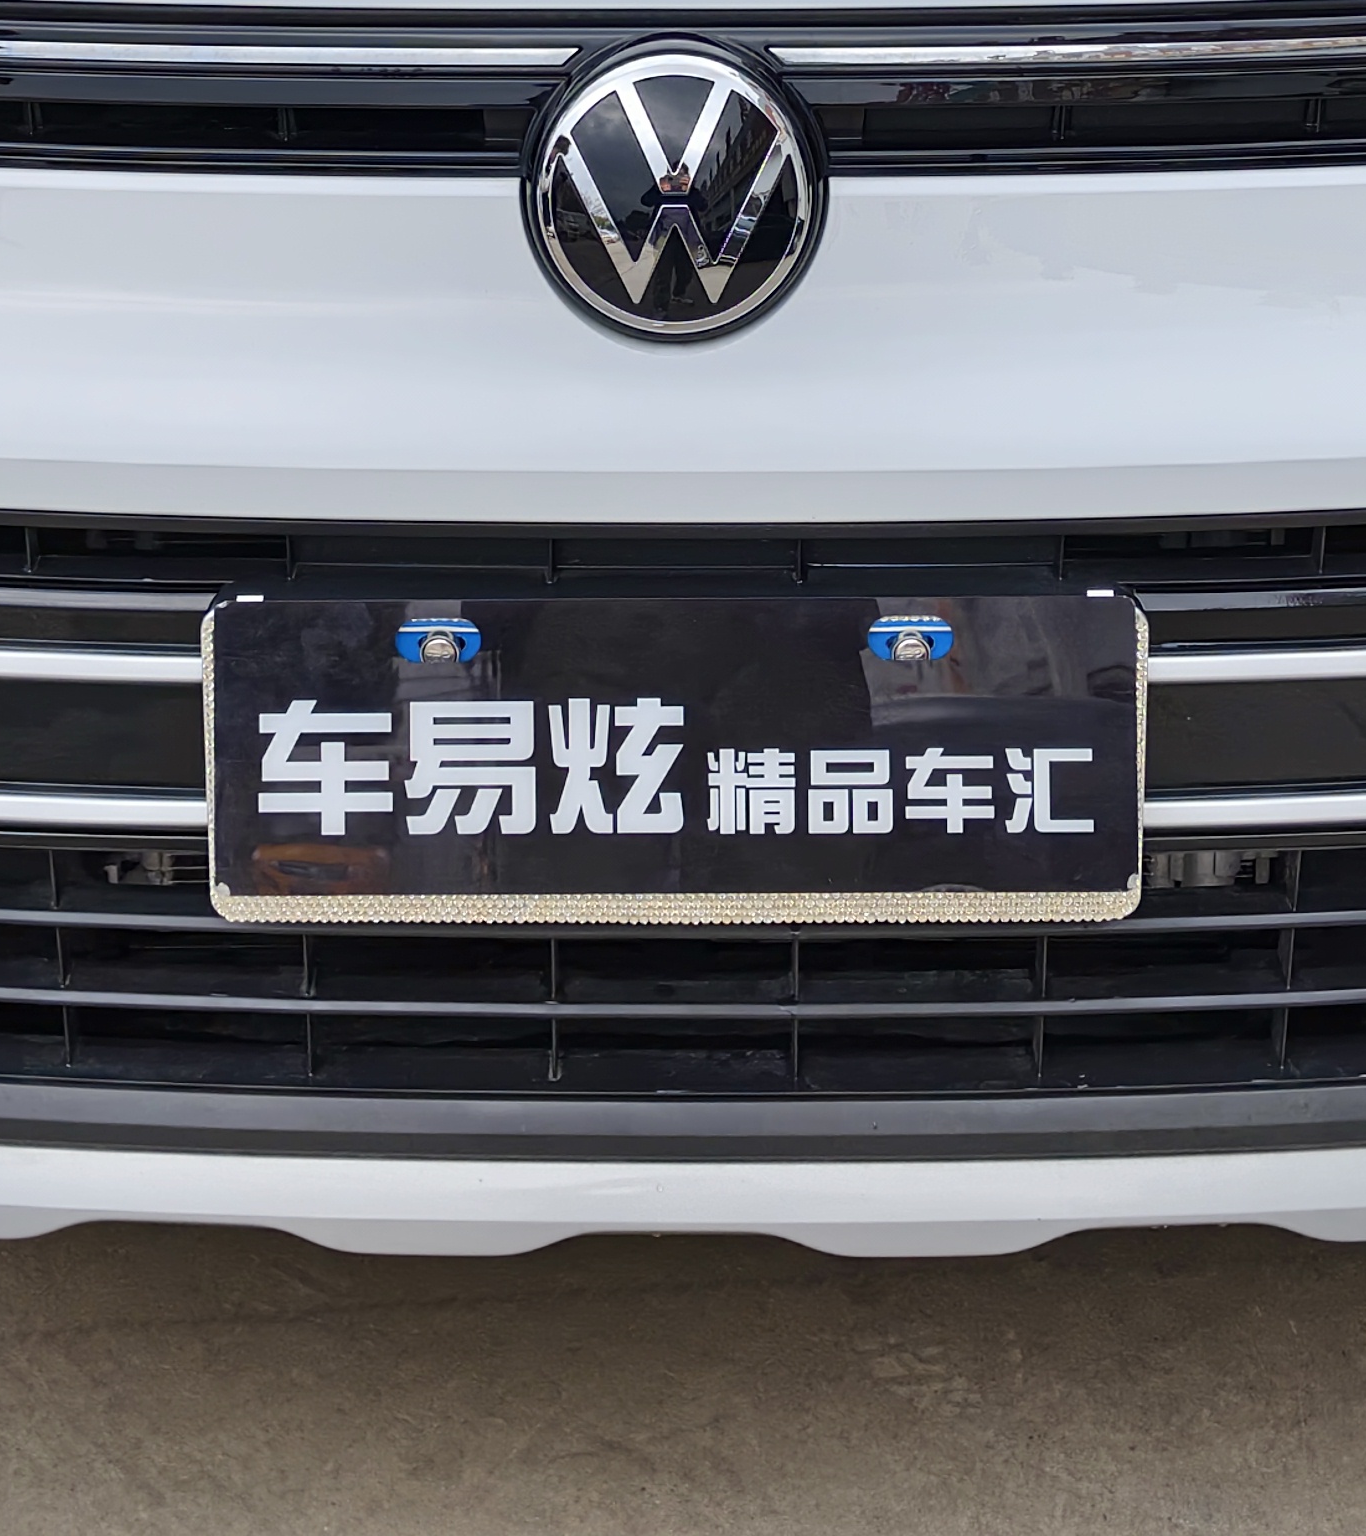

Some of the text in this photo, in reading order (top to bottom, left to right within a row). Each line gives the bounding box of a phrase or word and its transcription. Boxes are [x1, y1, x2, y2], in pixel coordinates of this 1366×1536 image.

[257, 697, 1095, 836] 车易炫 精品车汇
